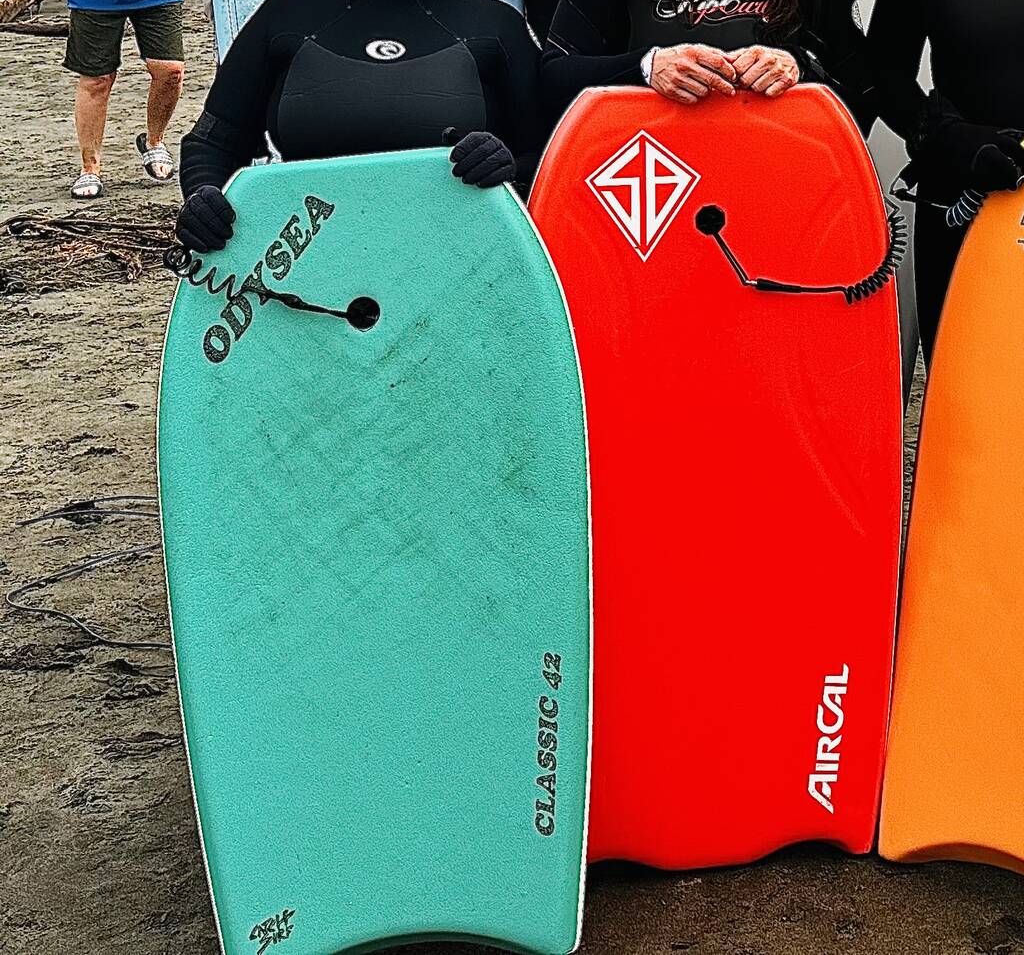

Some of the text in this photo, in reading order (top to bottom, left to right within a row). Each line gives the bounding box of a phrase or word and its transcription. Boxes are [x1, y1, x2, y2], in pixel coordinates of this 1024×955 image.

[202, 195, 335, 364] ODYSEA
[534, 651, 563, 837] CLASSIC 42
